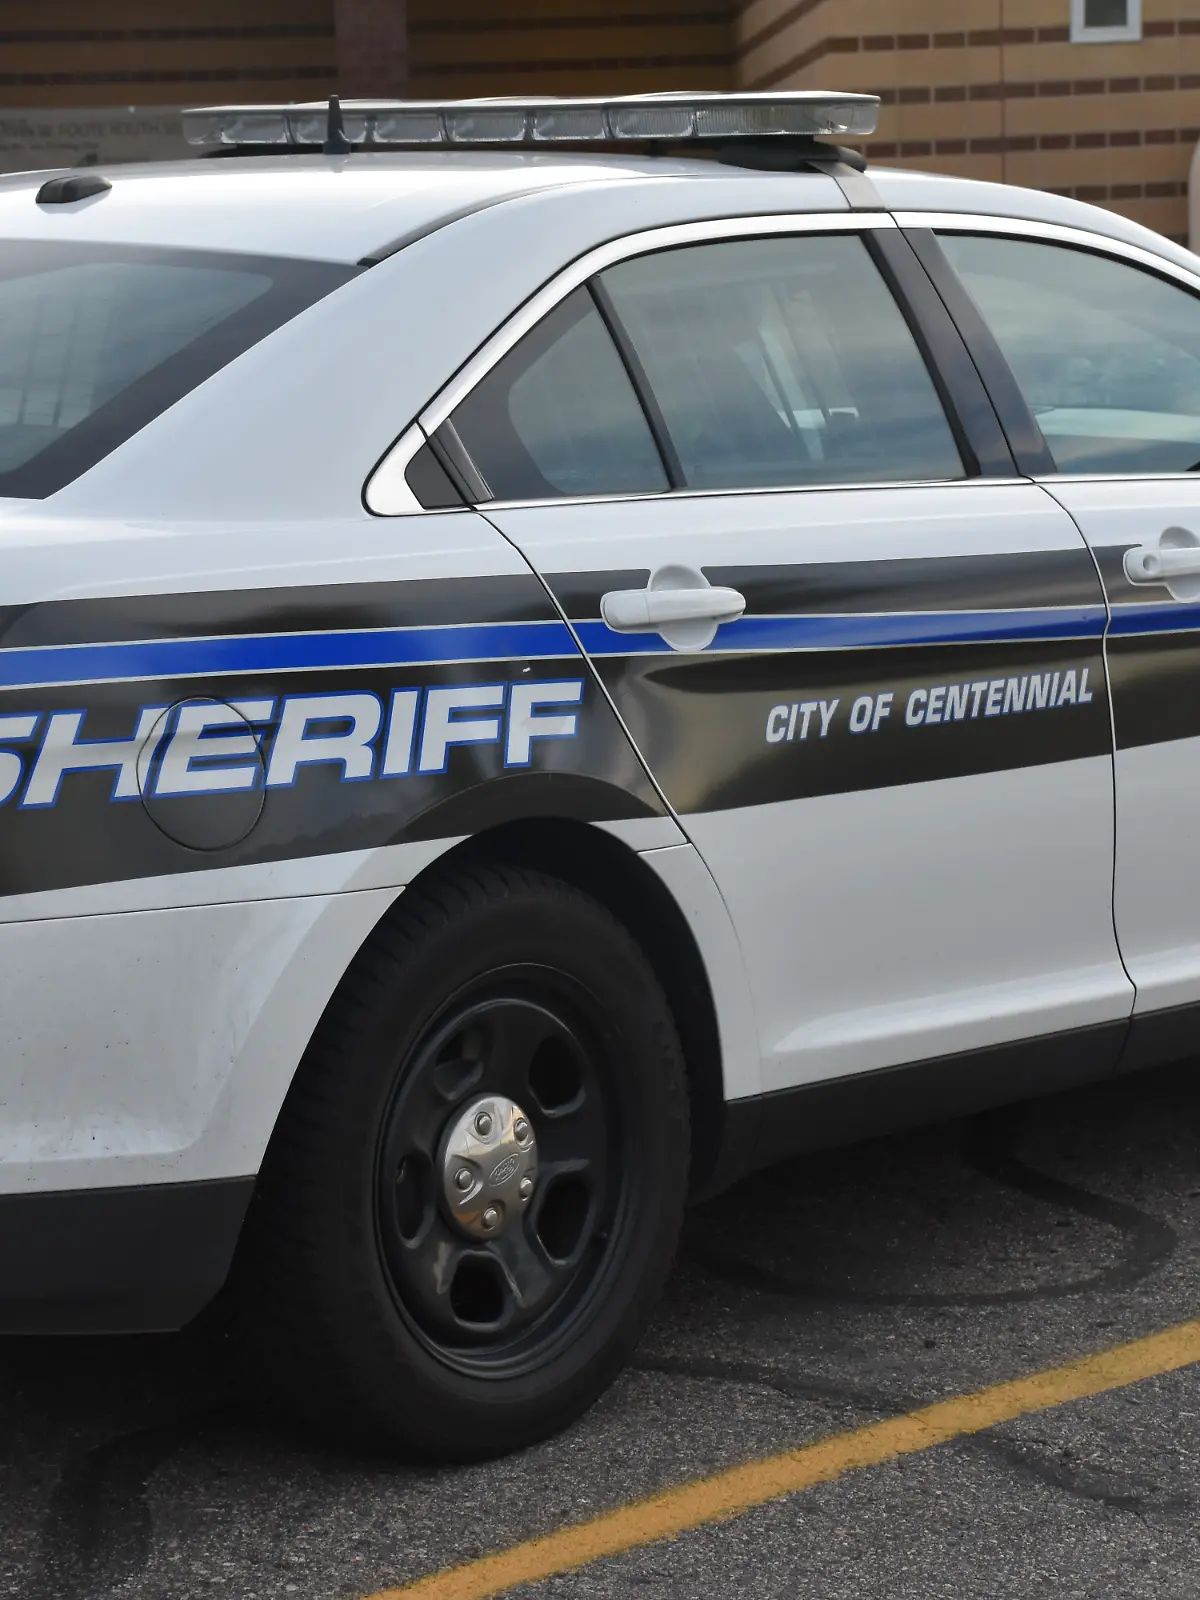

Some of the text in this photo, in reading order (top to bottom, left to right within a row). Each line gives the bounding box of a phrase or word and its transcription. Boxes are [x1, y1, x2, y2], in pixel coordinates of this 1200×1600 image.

[764, 667, 1094, 744] CITY OF CENTENNIAL
